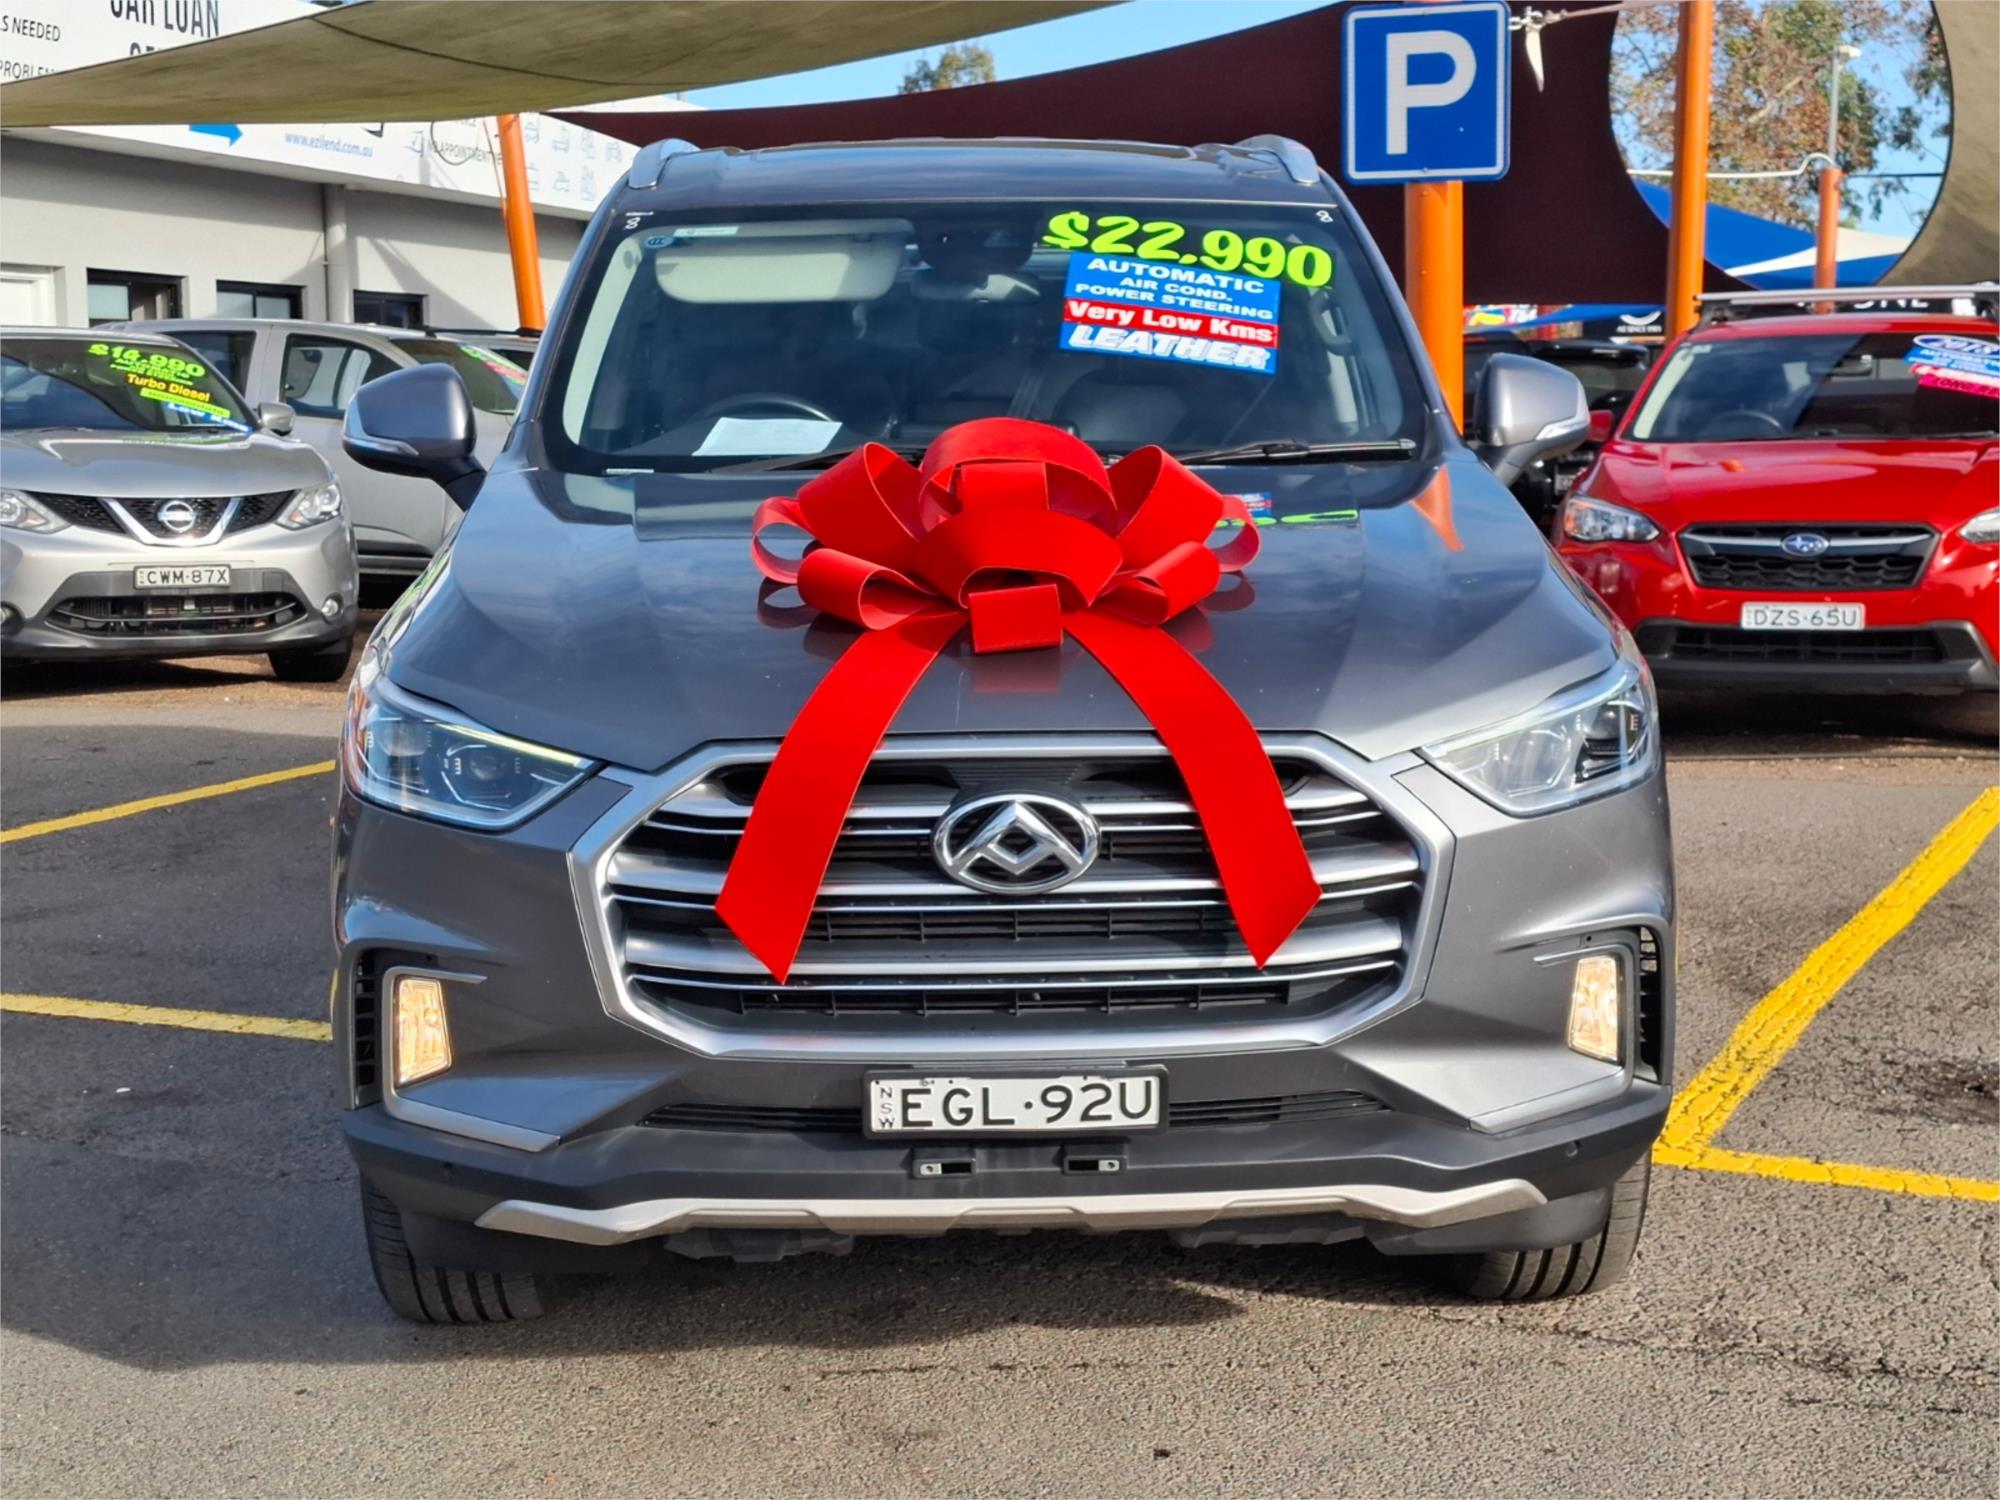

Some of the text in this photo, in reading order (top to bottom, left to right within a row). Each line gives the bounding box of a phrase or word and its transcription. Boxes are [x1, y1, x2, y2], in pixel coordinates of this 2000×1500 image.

[12, 17, 61, 42] NEEDED
[164, 0, 219, 38] LOAN
[1386, 30, 1477, 155] P
[1043, 211, 1332, 287] $22,990
[1087, 258, 1264, 294] AUTOMATIC
[1120, 277, 1233, 302] AIR COND.
[1075, 284, 1273, 320] POWER STEERING
[1069, 301, 1275, 343] Very Low Kms
[1069, 324, 1271, 370] LEATHER
[127, 373, 166, 390] Turbo
[169, 384, 210, 402] Diesel
